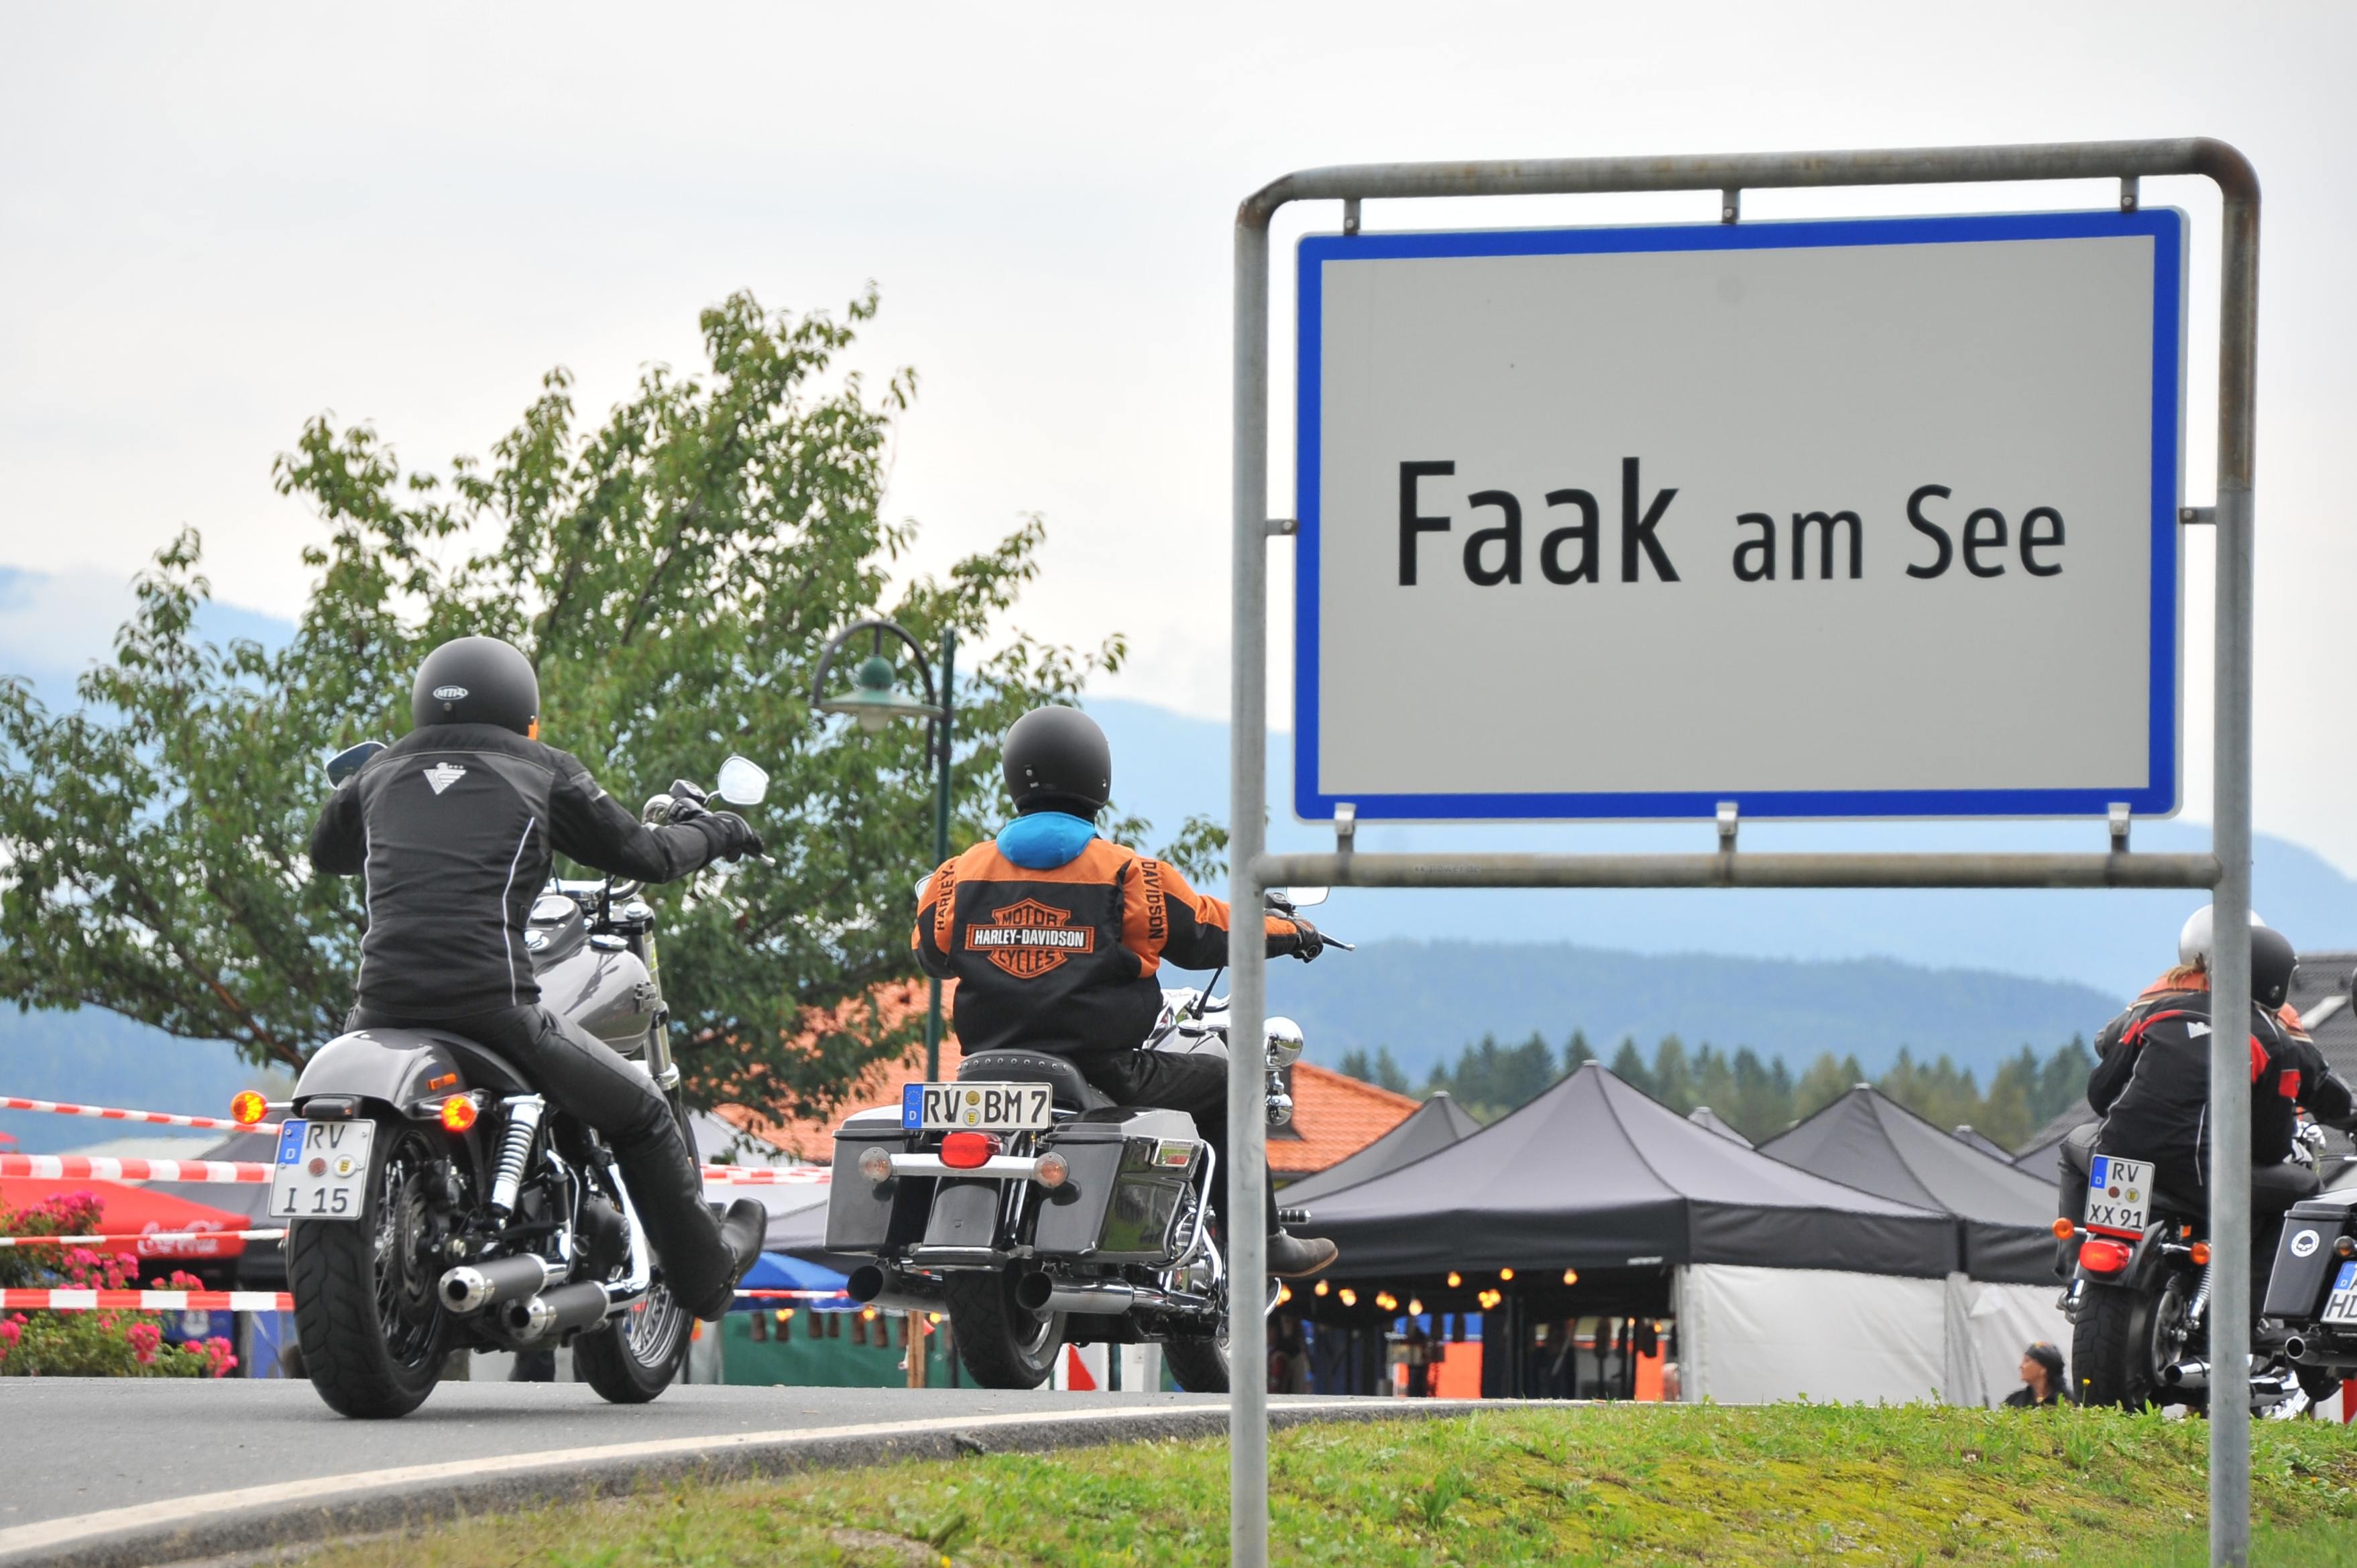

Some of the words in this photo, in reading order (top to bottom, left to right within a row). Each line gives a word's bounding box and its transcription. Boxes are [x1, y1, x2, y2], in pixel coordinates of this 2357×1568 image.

[1398, 456, 1681, 587] Faak
[1732, 509, 1863, 581] am
[1905, 483, 2065, 579] See
[1141, 861, 1164, 939] DAVIDSON
[1002, 905, 1057, 926] MOTOR
[974, 928, 1084, 947] HARLEY-DAVIDSON
[998, 949, 1055, 973] CYCLES
[923, 1090, 962, 1123] RV
[984, 1090, 1022, 1123] BM
[1030, 1090, 1047, 1123] 7
[305, 1124, 346, 1149] RV
[2112, 1162, 2139, 1183] RV
[310, 1187, 349, 1213] 15
[2089, 1204, 2115, 1225] XX
[2120, 1209, 2142, 1229] 91
